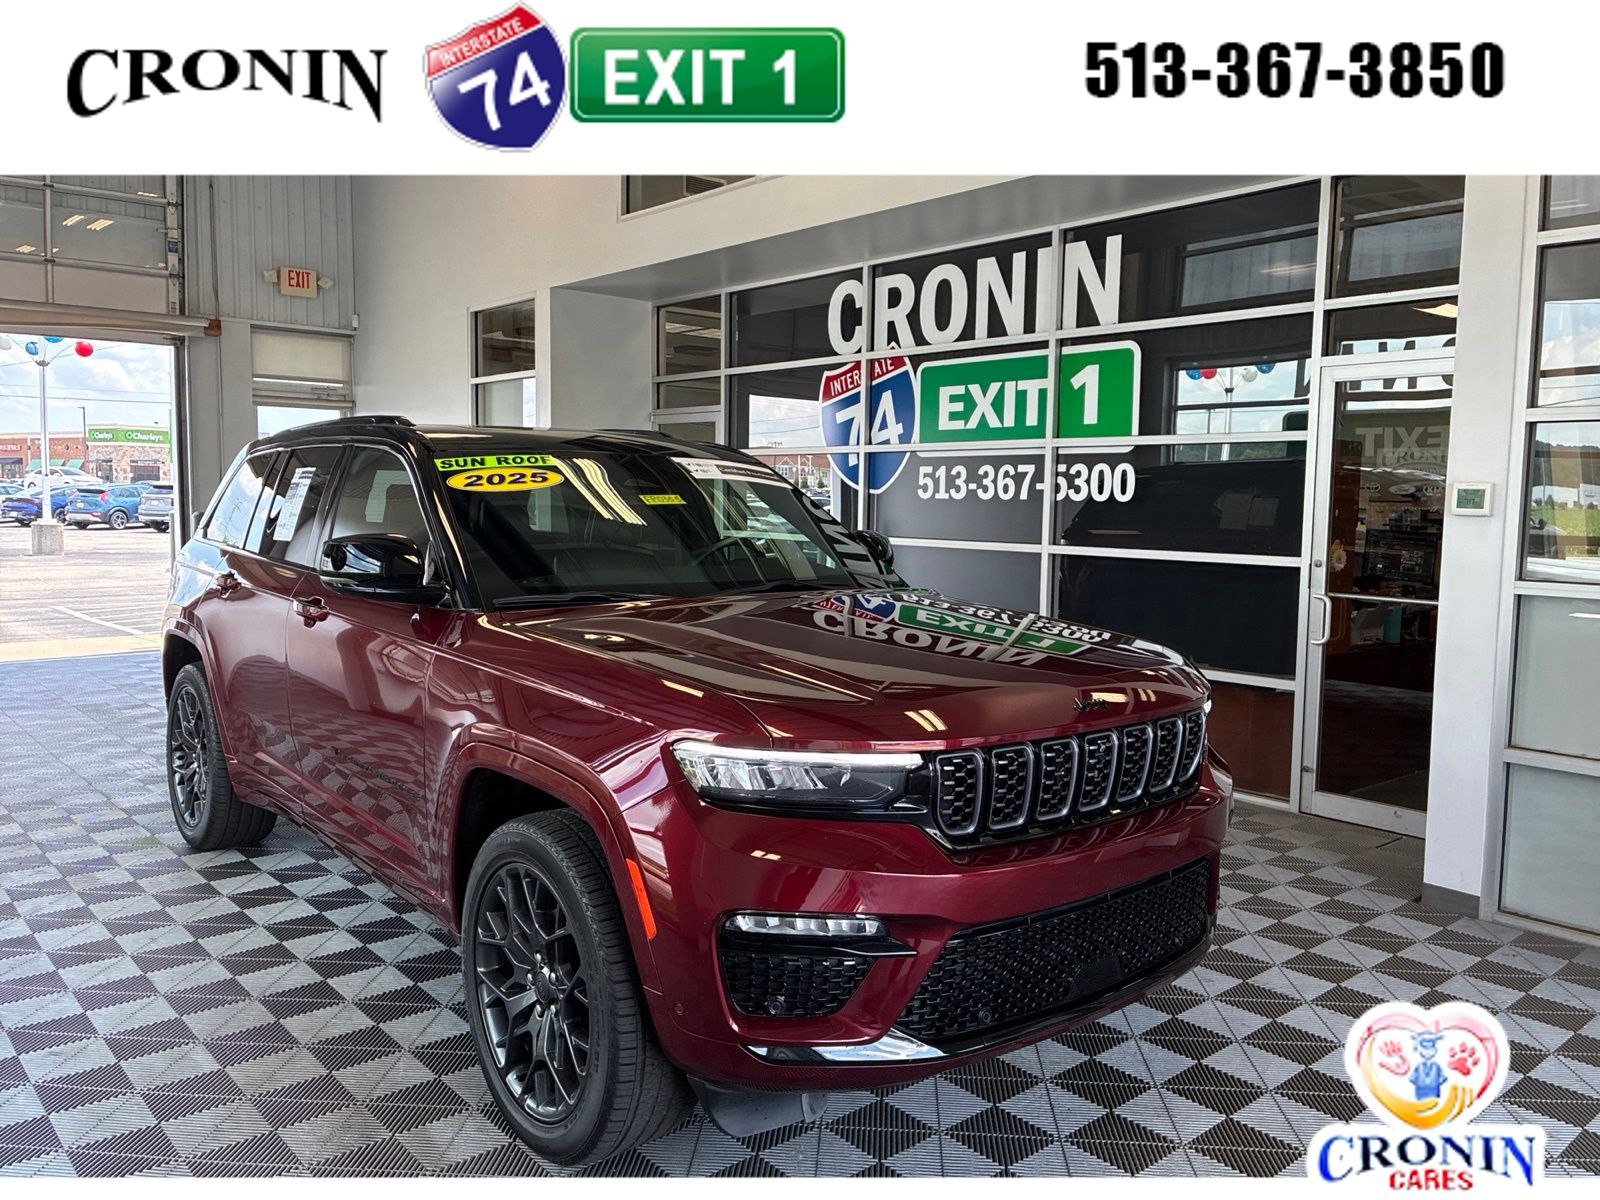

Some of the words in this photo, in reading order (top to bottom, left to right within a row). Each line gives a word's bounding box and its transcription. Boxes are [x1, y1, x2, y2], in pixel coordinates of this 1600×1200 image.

[288, 269, 311, 289] EXIT
[828, 234, 1123, 355] CRONIN
[830, 358, 895, 396] INTERATE
[938, 378, 1050, 432] EXIT
[1069, 364, 1100, 425] 1
[835, 390, 905, 467] 74
[440, 457, 485, 469] SUN
[495, 455, 553, 465] ROOF
[463, 471, 549, 488] 2025
[917, 462, 1136, 502] 513-367-5300
